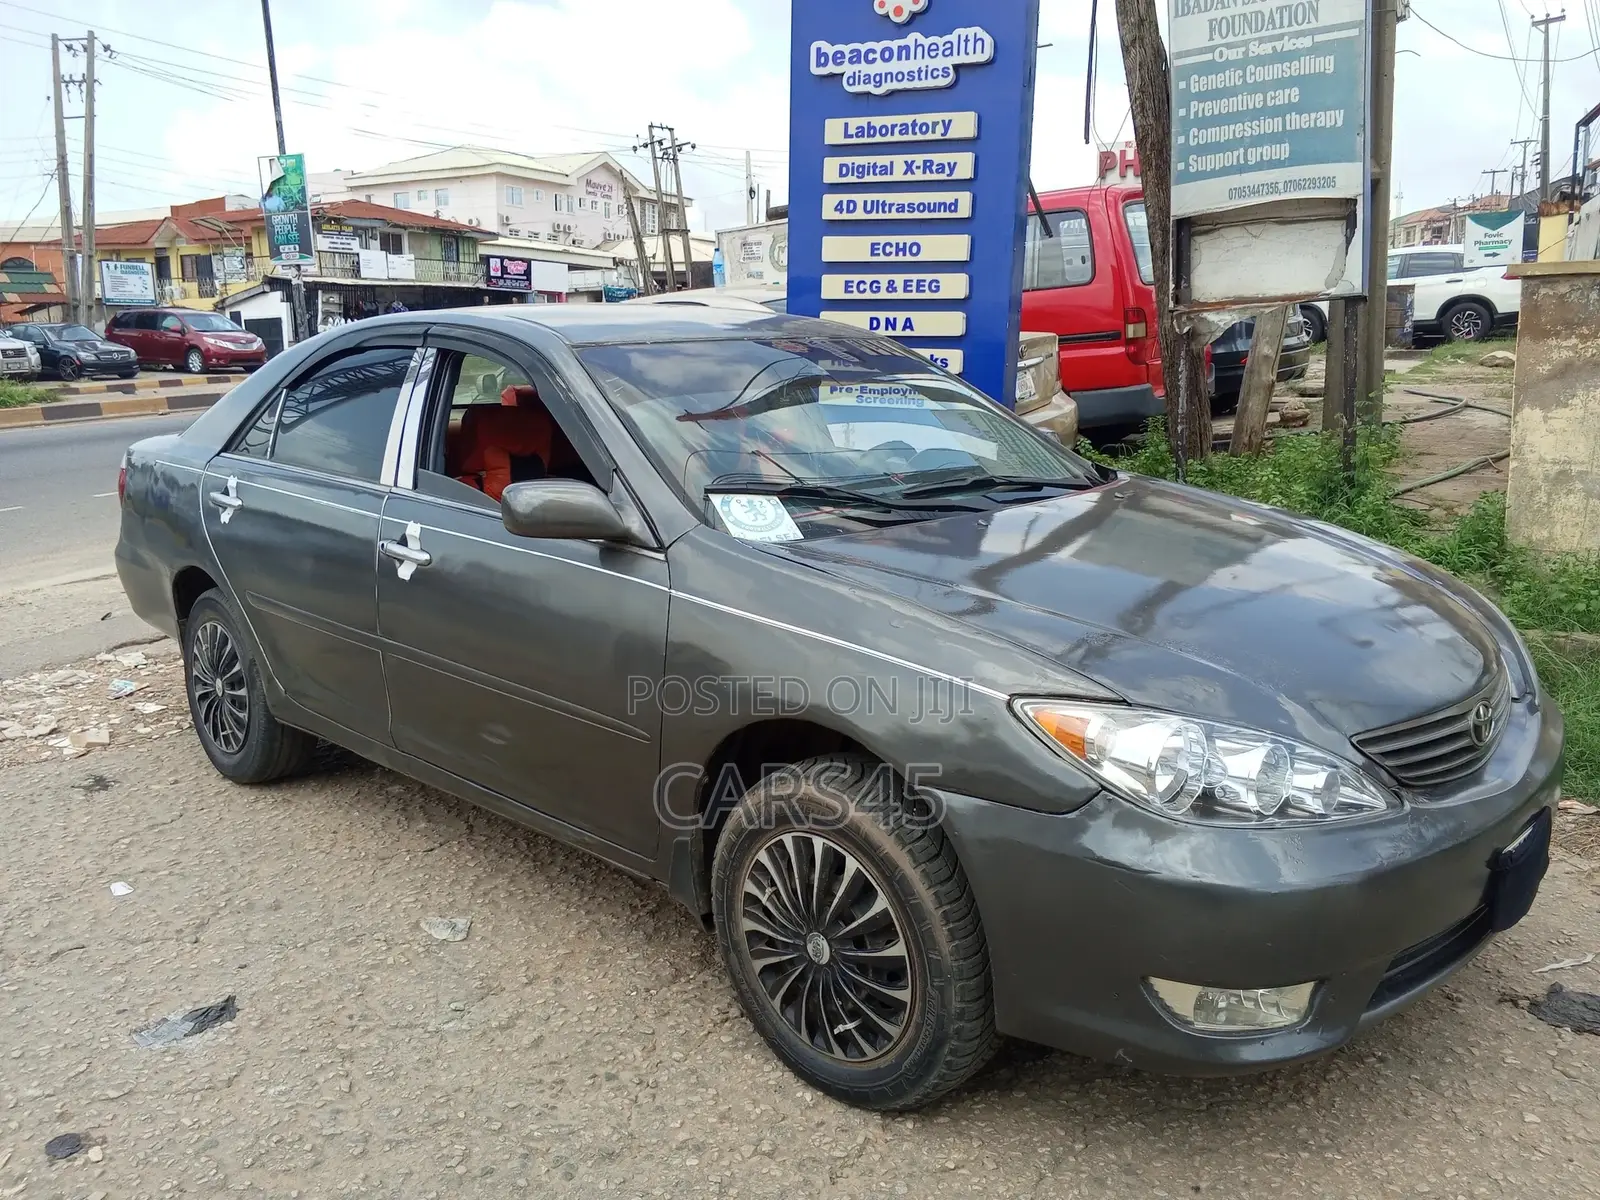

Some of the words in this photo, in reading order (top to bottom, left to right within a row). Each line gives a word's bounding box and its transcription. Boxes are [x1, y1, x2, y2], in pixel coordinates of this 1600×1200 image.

[1207, 0, 1319, 41] FOUNDATION
[815, 32, 985, 68] beaconhealth
[1214, 47, 1246, 62] Our
[1249, 35, 1313, 57] Services
[846, 64, 951, 88] diagnostics
[1190, 68, 1243, 93] Genetic
[1245, 55, 1334, 83] Counselling
[1190, 92, 1264, 119] Preventive
[1266, 86, 1300, 106] care
[843, 119, 953, 139] Laboratory
[1189, 116, 1282, 146] Compression
[1285, 109, 1345, 130] therapy
[1189, 148, 1245, 173] Support
[1248, 142, 1290, 165] group
[839, 161, 894, 179] Digital
[903, 159, 958, 177] X-Ray
[1229, 184, 1282, 200] 07053447356,
[1283, 176, 1336, 193] 07062293205
[834, 200, 857, 214] 4D
[863, 198, 959, 214] Ultrasound
[271, 213, 298, 225] GROWTH
[274, 223, 297, 235] PEOPLE
[274, 234, 288, 244] CAN
[288, 233, 300, 244] SEE
[1473, 239, 1513, 247] Pharmacy
[1484, 231, 1504, 239] Fovic
[870, 241, 921, 257] ECHO
[844, 280, 881, 294] ECG
[885, 279, 898, 293] &
[903, 279, 941, 293] EEG
[869, 317, 915, 332] DNA
[855, 394, 925, 408] Screening
